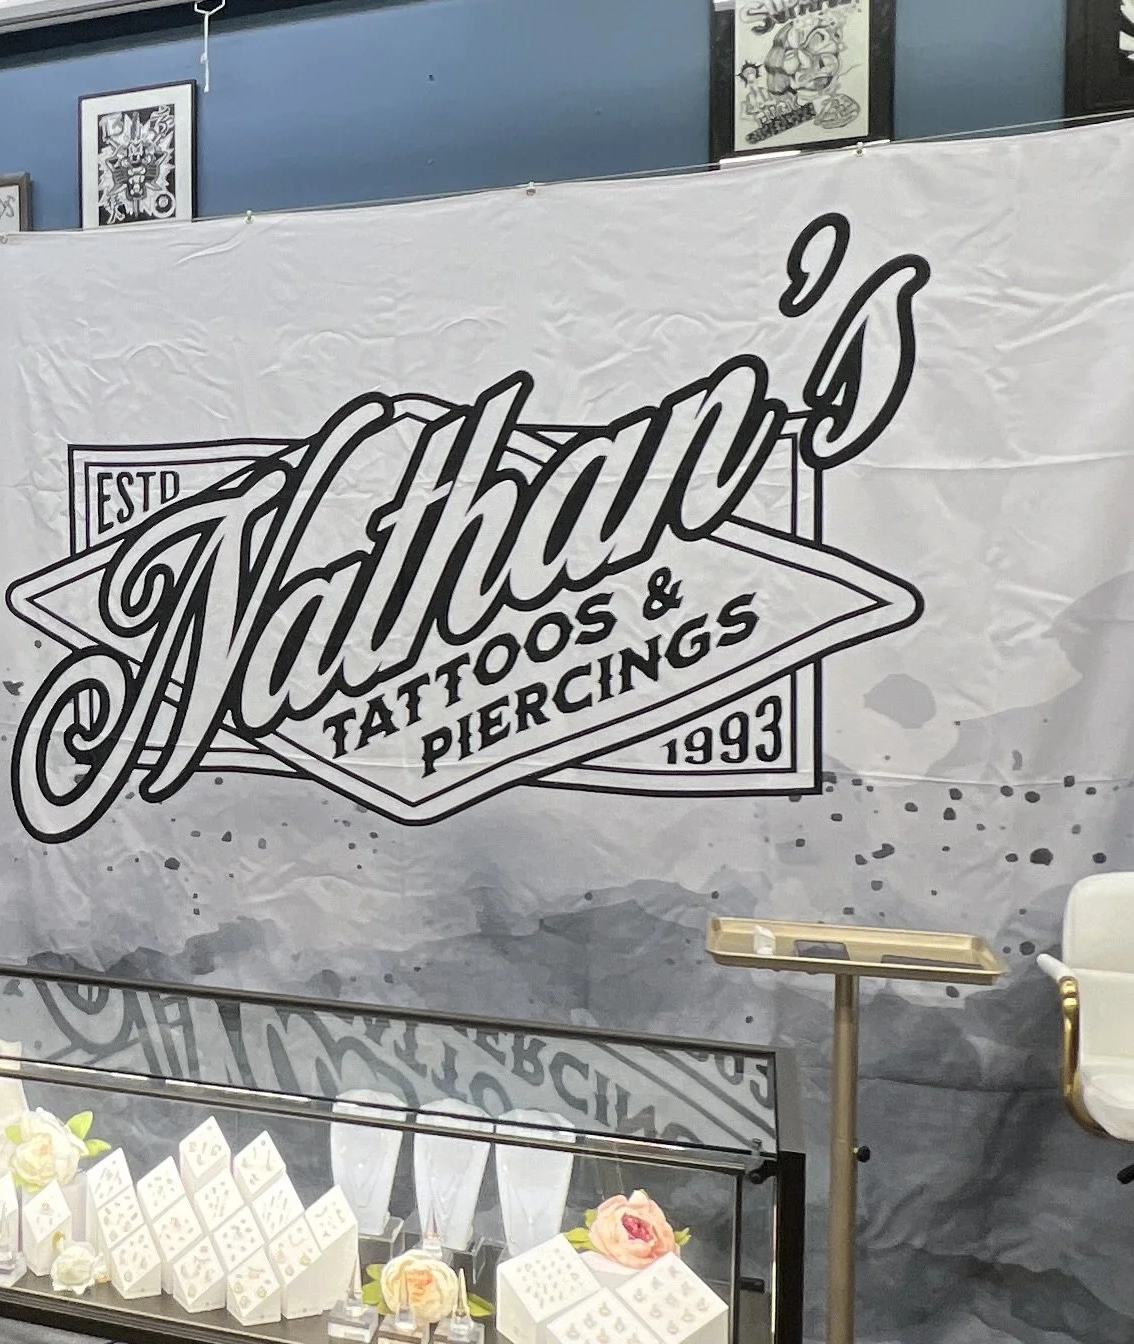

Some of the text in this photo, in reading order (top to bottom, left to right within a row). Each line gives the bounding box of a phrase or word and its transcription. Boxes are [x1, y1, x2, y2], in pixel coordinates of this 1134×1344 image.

[9, 212, 931, 844] Nathan's
[97, 470, 180, 535] ESTD
[323, 567, 683, 759] TATTOOS &
[421, 592, 759, 778] PIERCINGS
[663, 696, 782, 764] 1993
